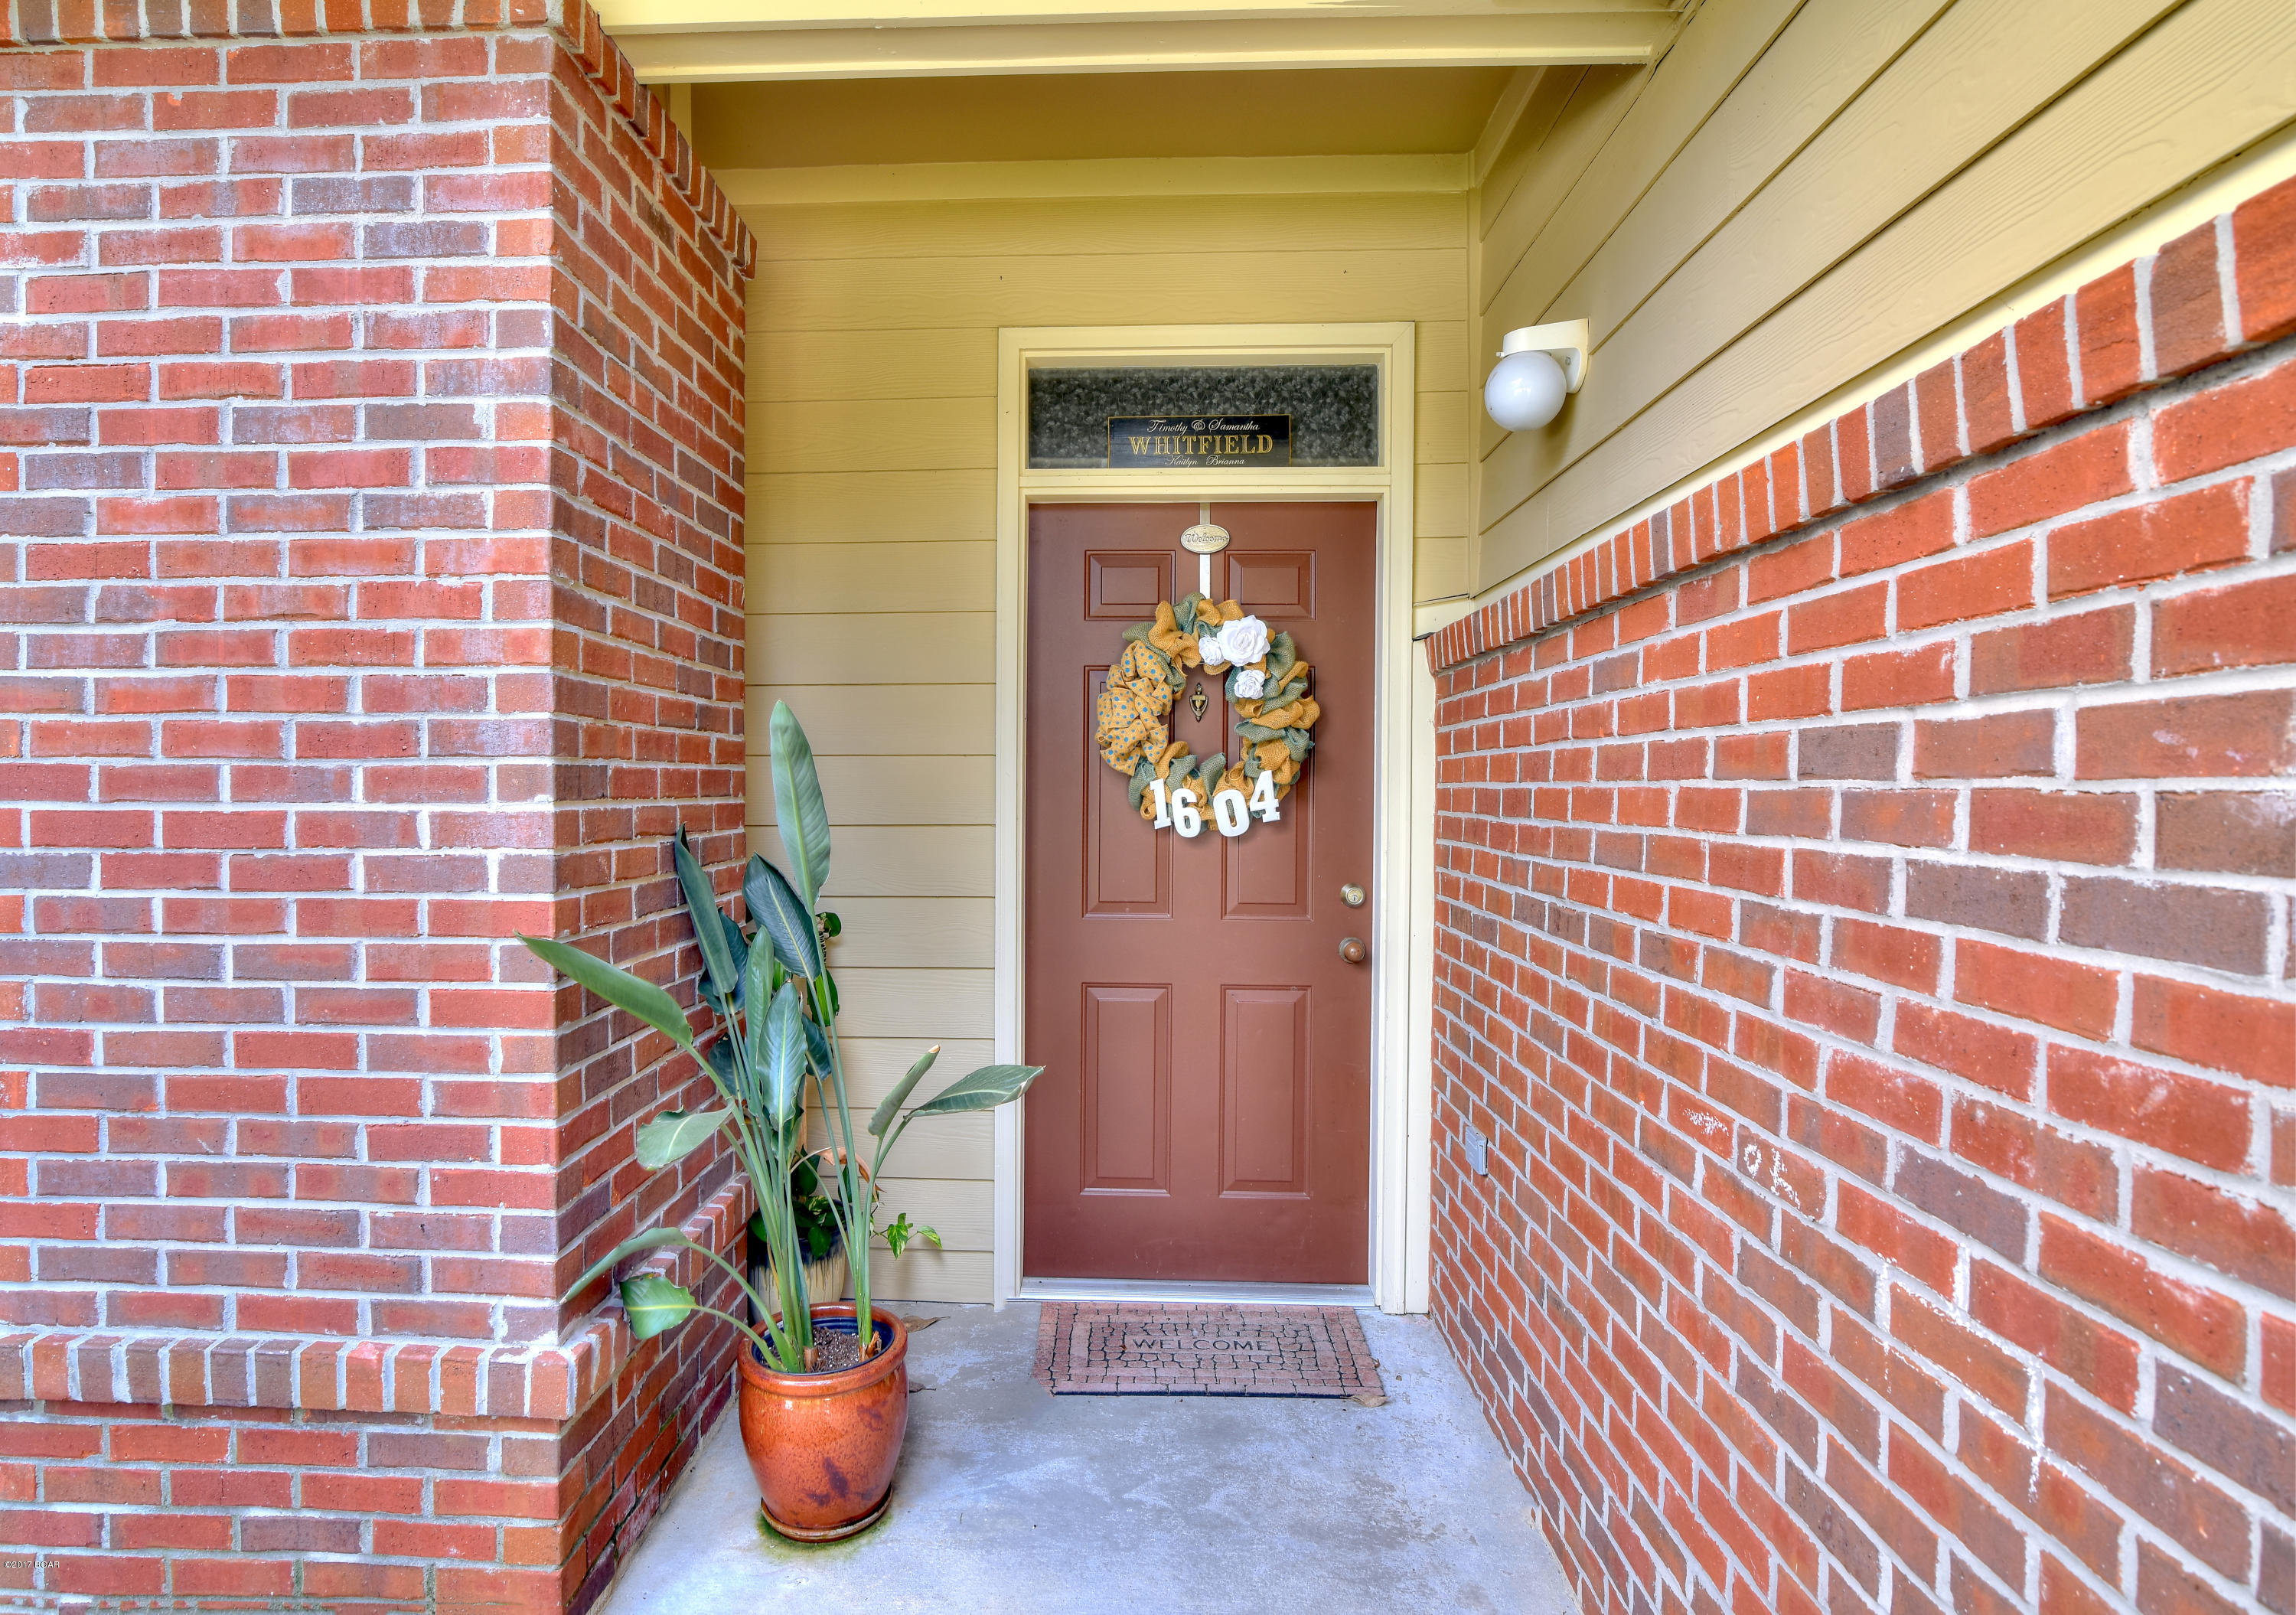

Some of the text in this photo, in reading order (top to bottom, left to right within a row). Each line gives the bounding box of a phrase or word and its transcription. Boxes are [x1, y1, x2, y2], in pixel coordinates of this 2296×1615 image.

[1147, 418, 1261, 436] Timothy & Samantha
[1129, 434, 1274, 455] WHITFIELD
[1206, 455, 1246, 466] Brianna
[1184, 533, 1227, 543] Welcome
[1150, 770, 1280, 838] 1604
[1132, 1339, 1274, 1351] WELCOME
